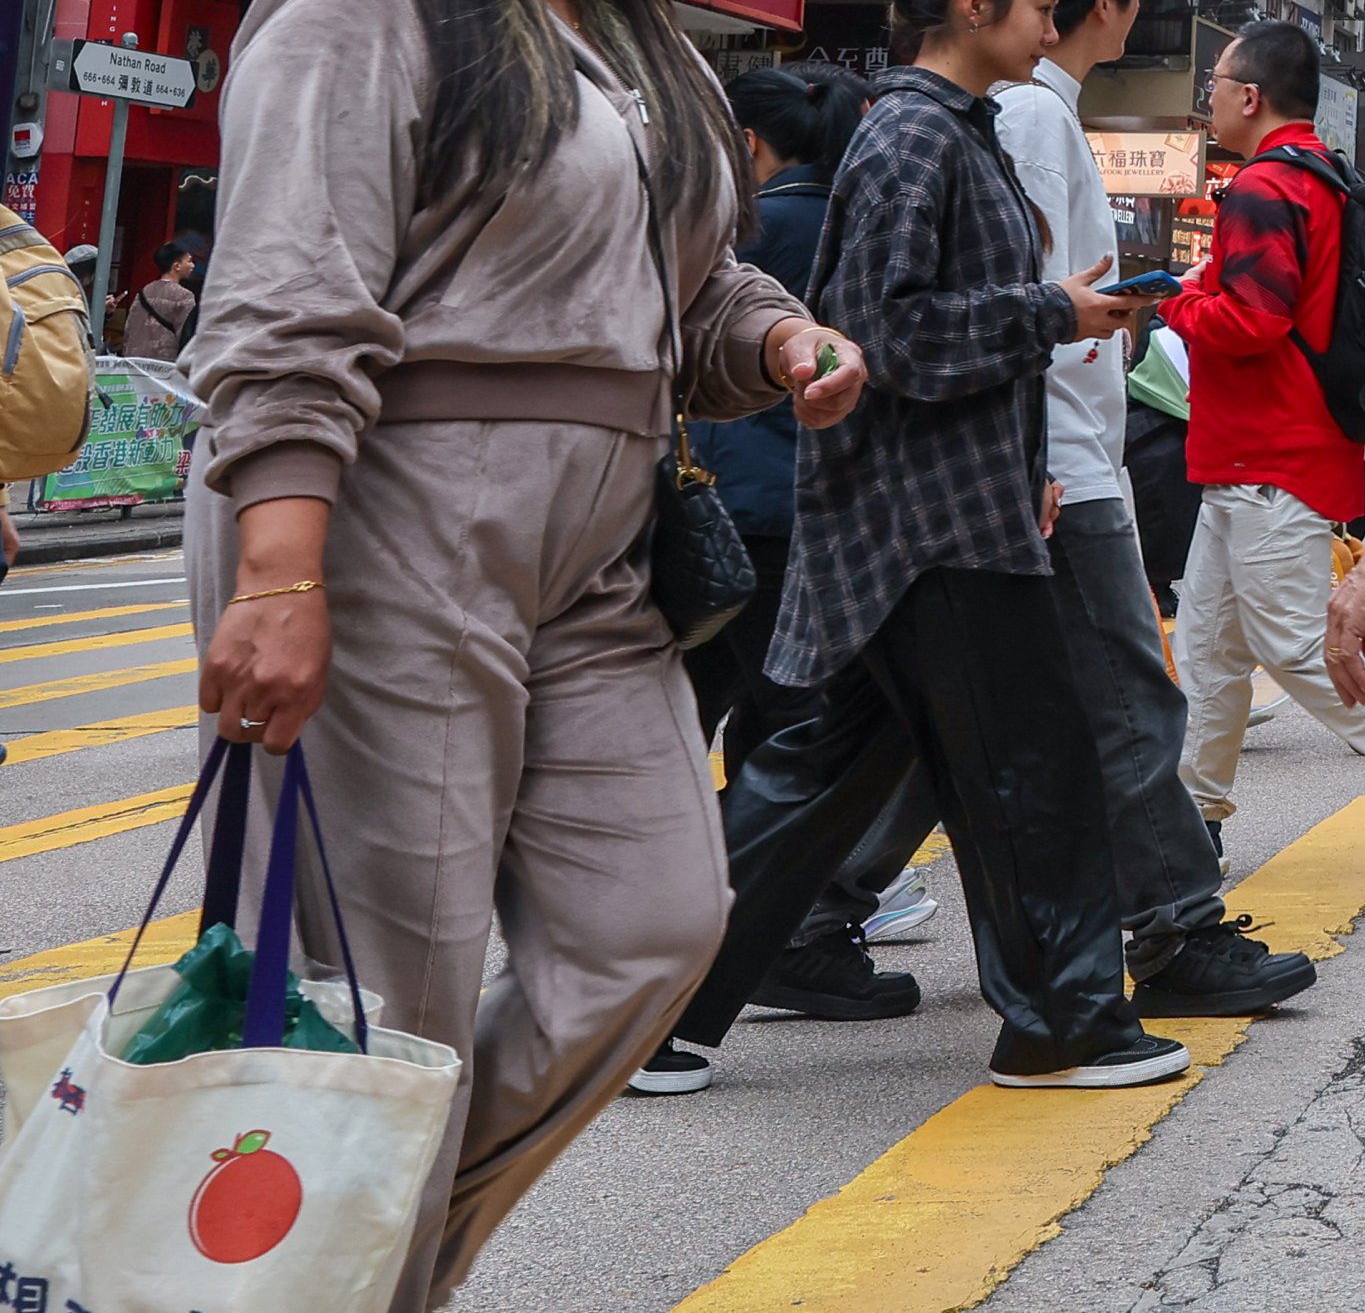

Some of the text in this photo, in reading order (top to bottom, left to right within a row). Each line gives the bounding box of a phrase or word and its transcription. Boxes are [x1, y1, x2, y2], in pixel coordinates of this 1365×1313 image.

[109, 52, 166, 74] Nathan Road
[118, 74, 153, 96] 彌敦道
[6, 173, 38, 184] ACA
